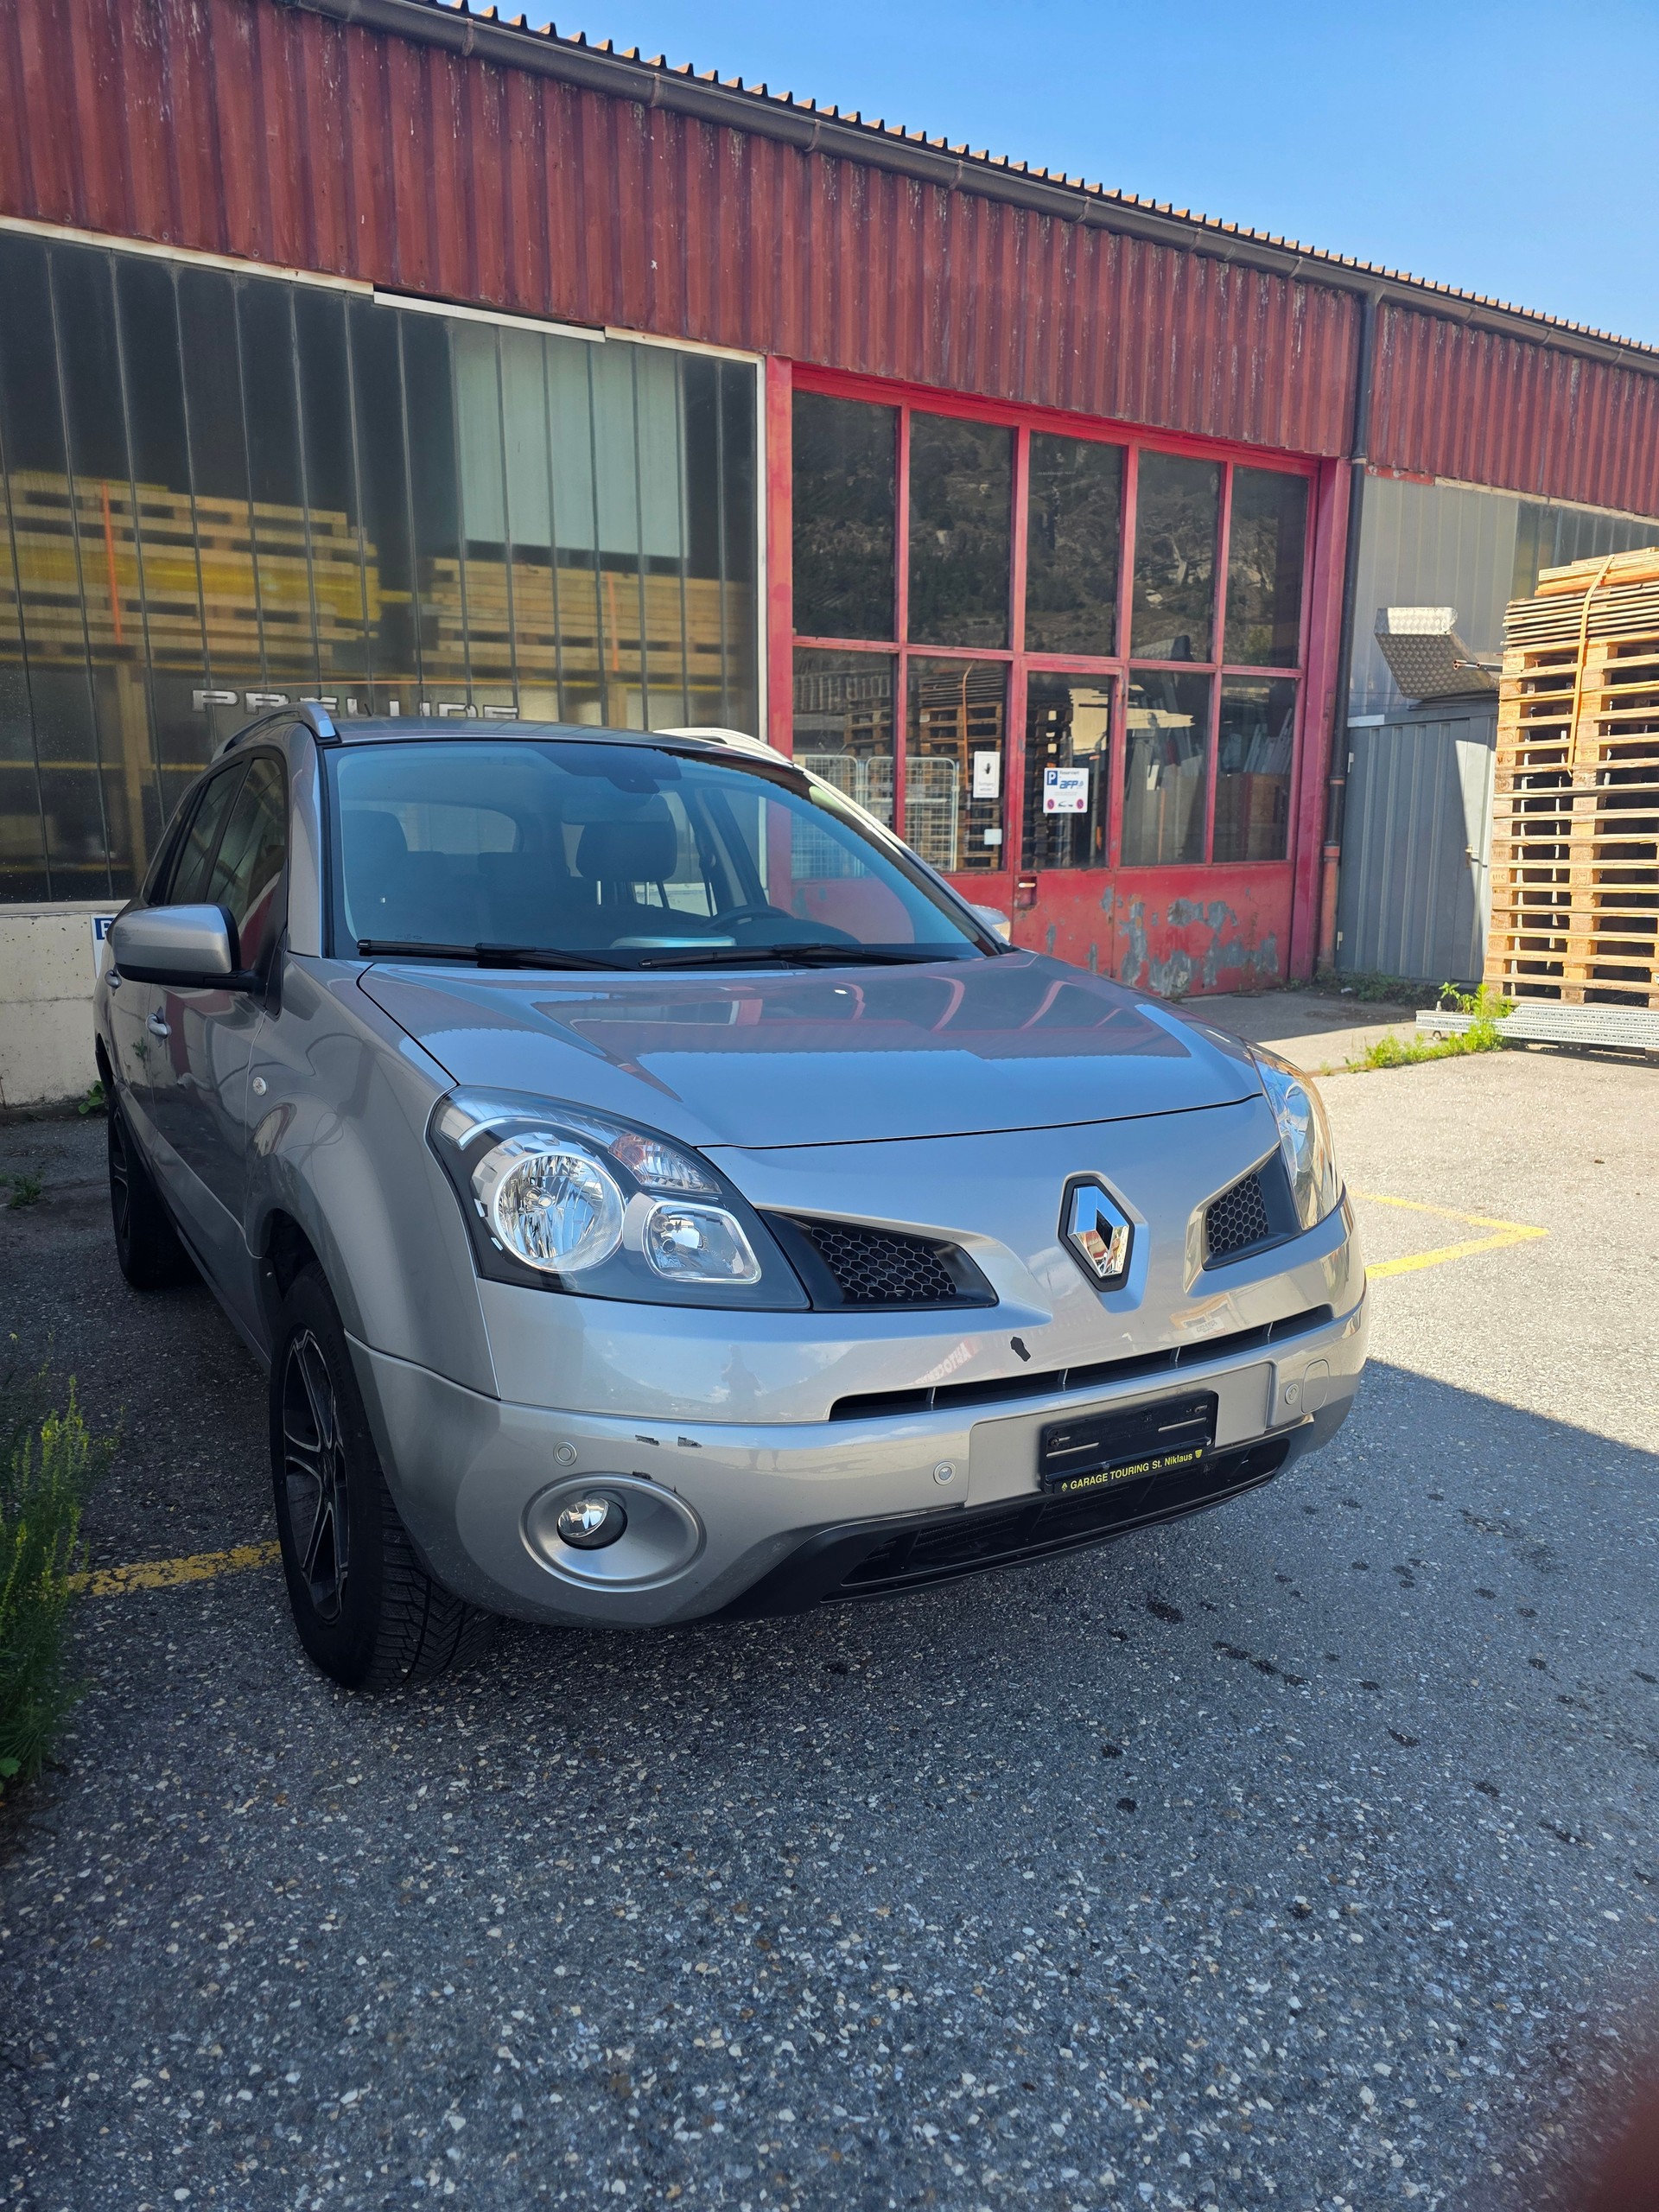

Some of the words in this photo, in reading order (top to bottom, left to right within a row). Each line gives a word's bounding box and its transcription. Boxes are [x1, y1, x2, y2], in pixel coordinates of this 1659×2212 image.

[1070, 1472, 1108, 1490] GARAGE
[1109, 1463, 1149, 1480] TOURING
[1152, 1459, 1162, 1470] St.
[1164, 1453, 1192, 1466] Niklaus
